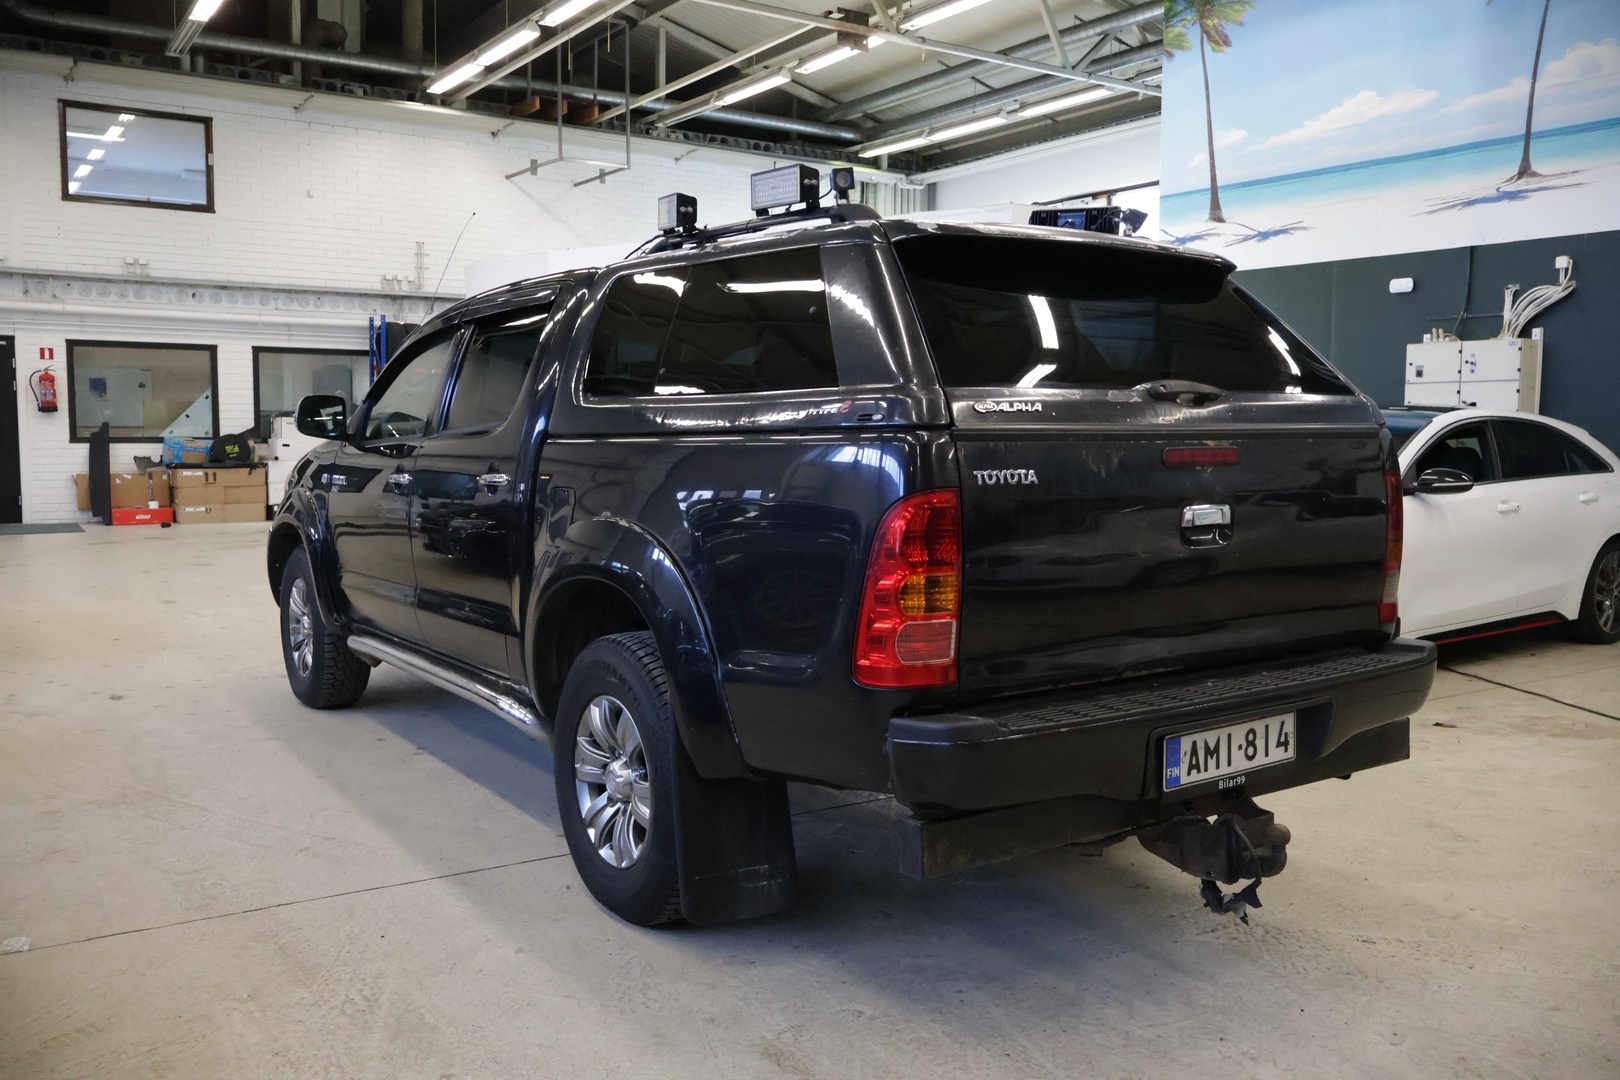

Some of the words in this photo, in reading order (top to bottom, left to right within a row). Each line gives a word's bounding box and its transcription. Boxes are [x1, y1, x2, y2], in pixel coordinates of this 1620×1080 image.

[996, 402, 1043, 412] ALPHA
[973, 469, 1039, 485] TOYOTA
[1186, 720, 1290, 777] AMI-814
[1166, 766, 1180, 779] FIN
[1218, 775, 1246, 790] Bilar99
